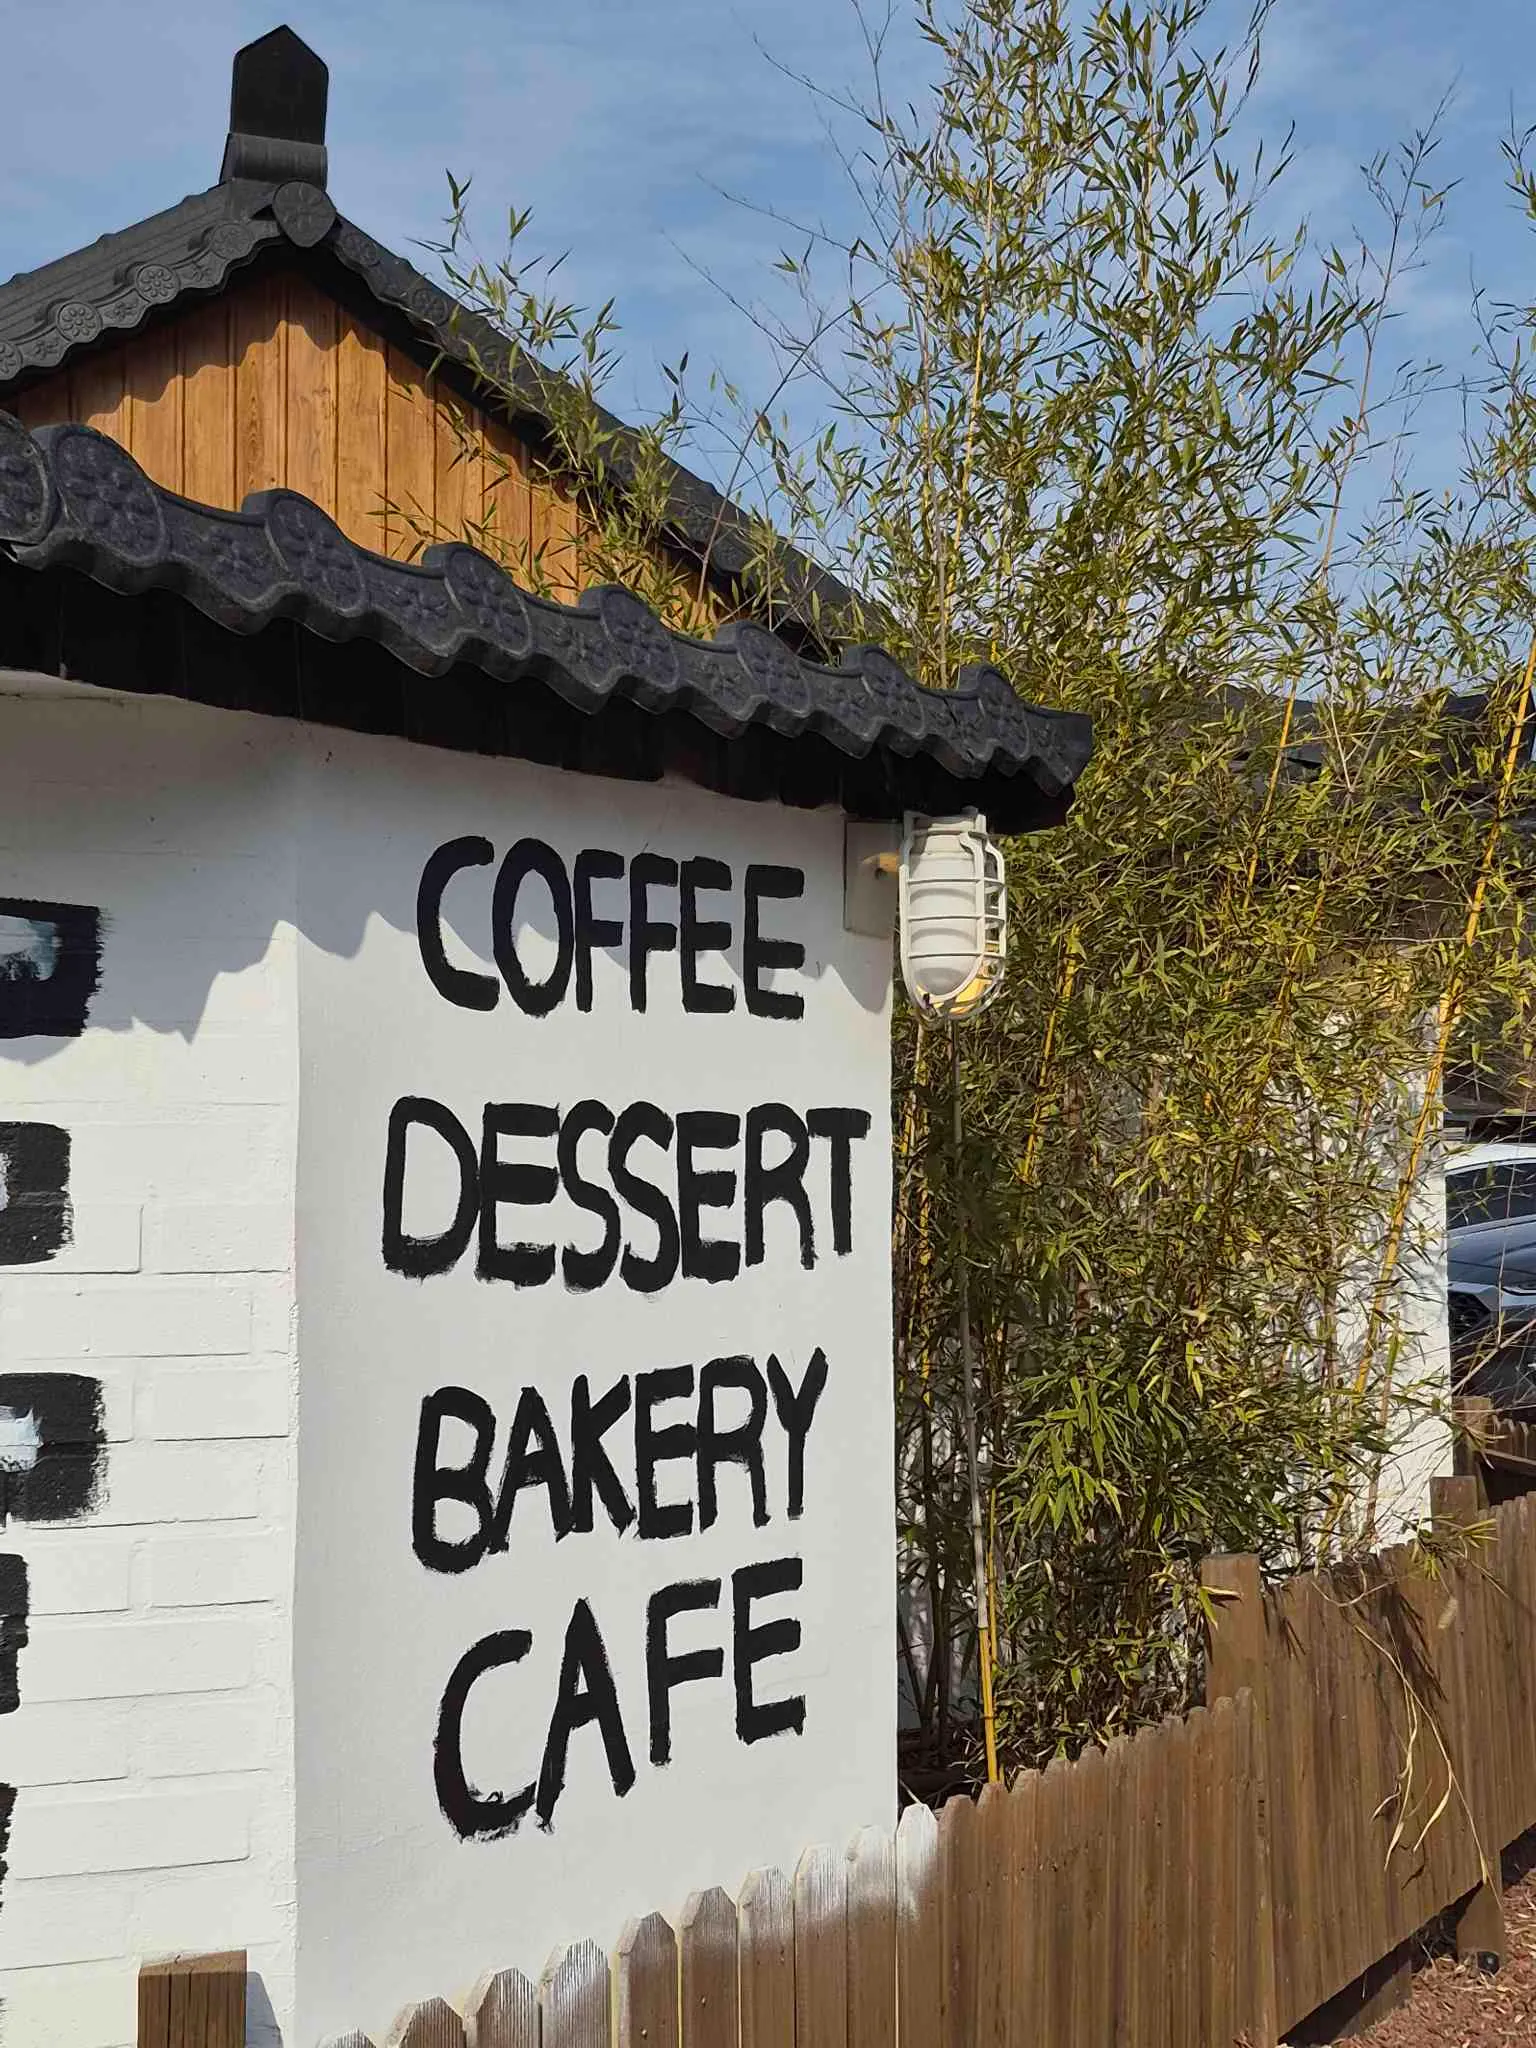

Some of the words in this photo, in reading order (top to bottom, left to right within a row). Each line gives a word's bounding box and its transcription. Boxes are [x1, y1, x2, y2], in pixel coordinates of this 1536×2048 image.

[417, 836, 806, 1019] COFFEE
[382, 1096, 871, 1293] DESSERT
[413, 1348, 828, 1574] BAKERY
[433, 1558, 806, 1841] CAFE
